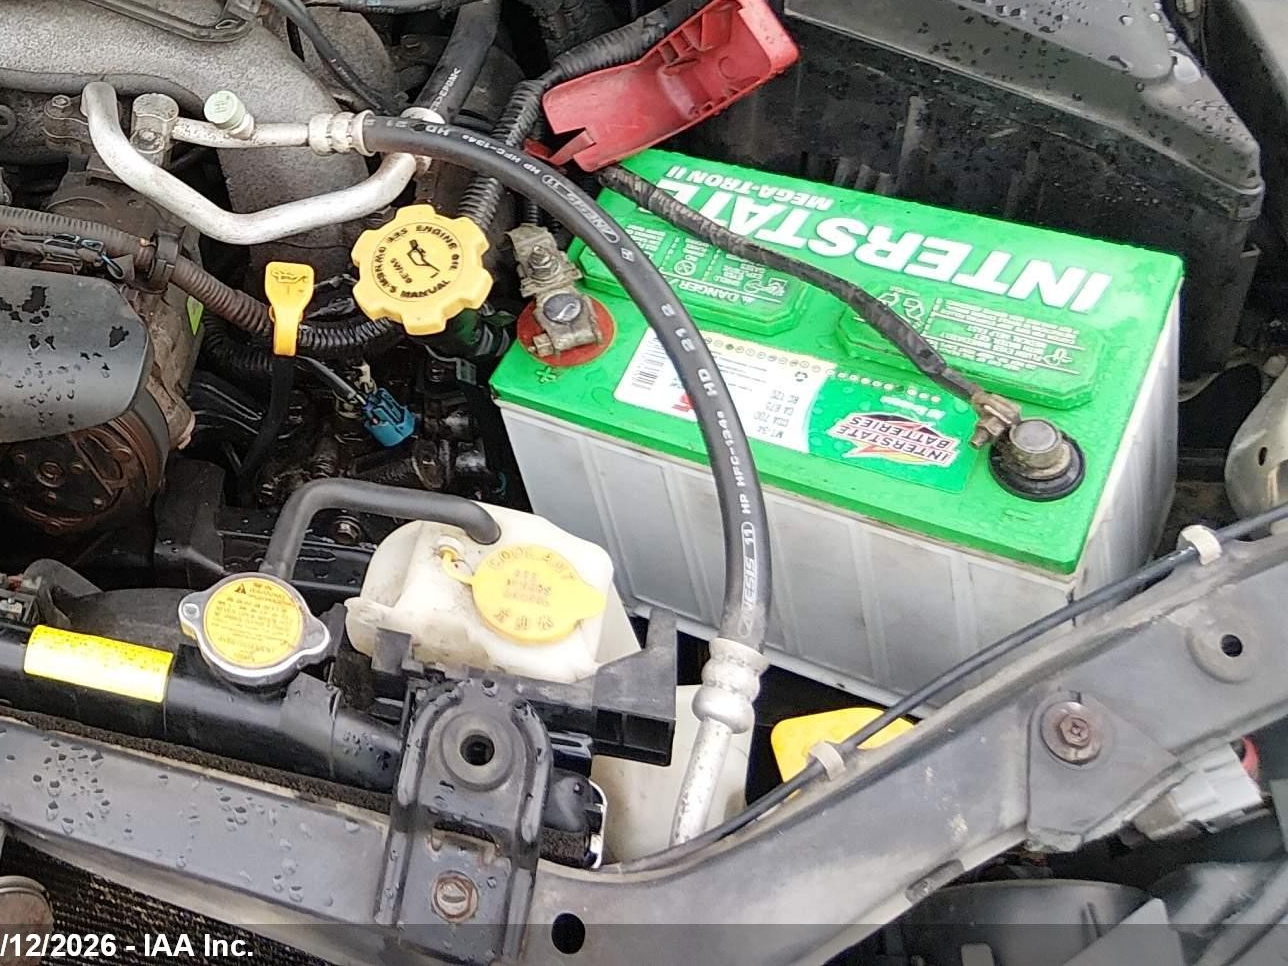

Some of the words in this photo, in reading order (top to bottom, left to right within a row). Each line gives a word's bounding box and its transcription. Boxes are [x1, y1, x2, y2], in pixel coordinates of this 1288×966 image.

[425, 124, 449, 137] HD
[523, 162, 541, 175] HP
[415, 224, 458, 250] ENGINE
[449, 253, 461, 271] OIL
[399, 278, 452, 299] MANUAL
[697, 368, 719, 397] HD
[835, 425, 950, 462] INTERSTATE
[849, 416, 951, 449] BATTERIES
[739, 493, 752, 515] HP
